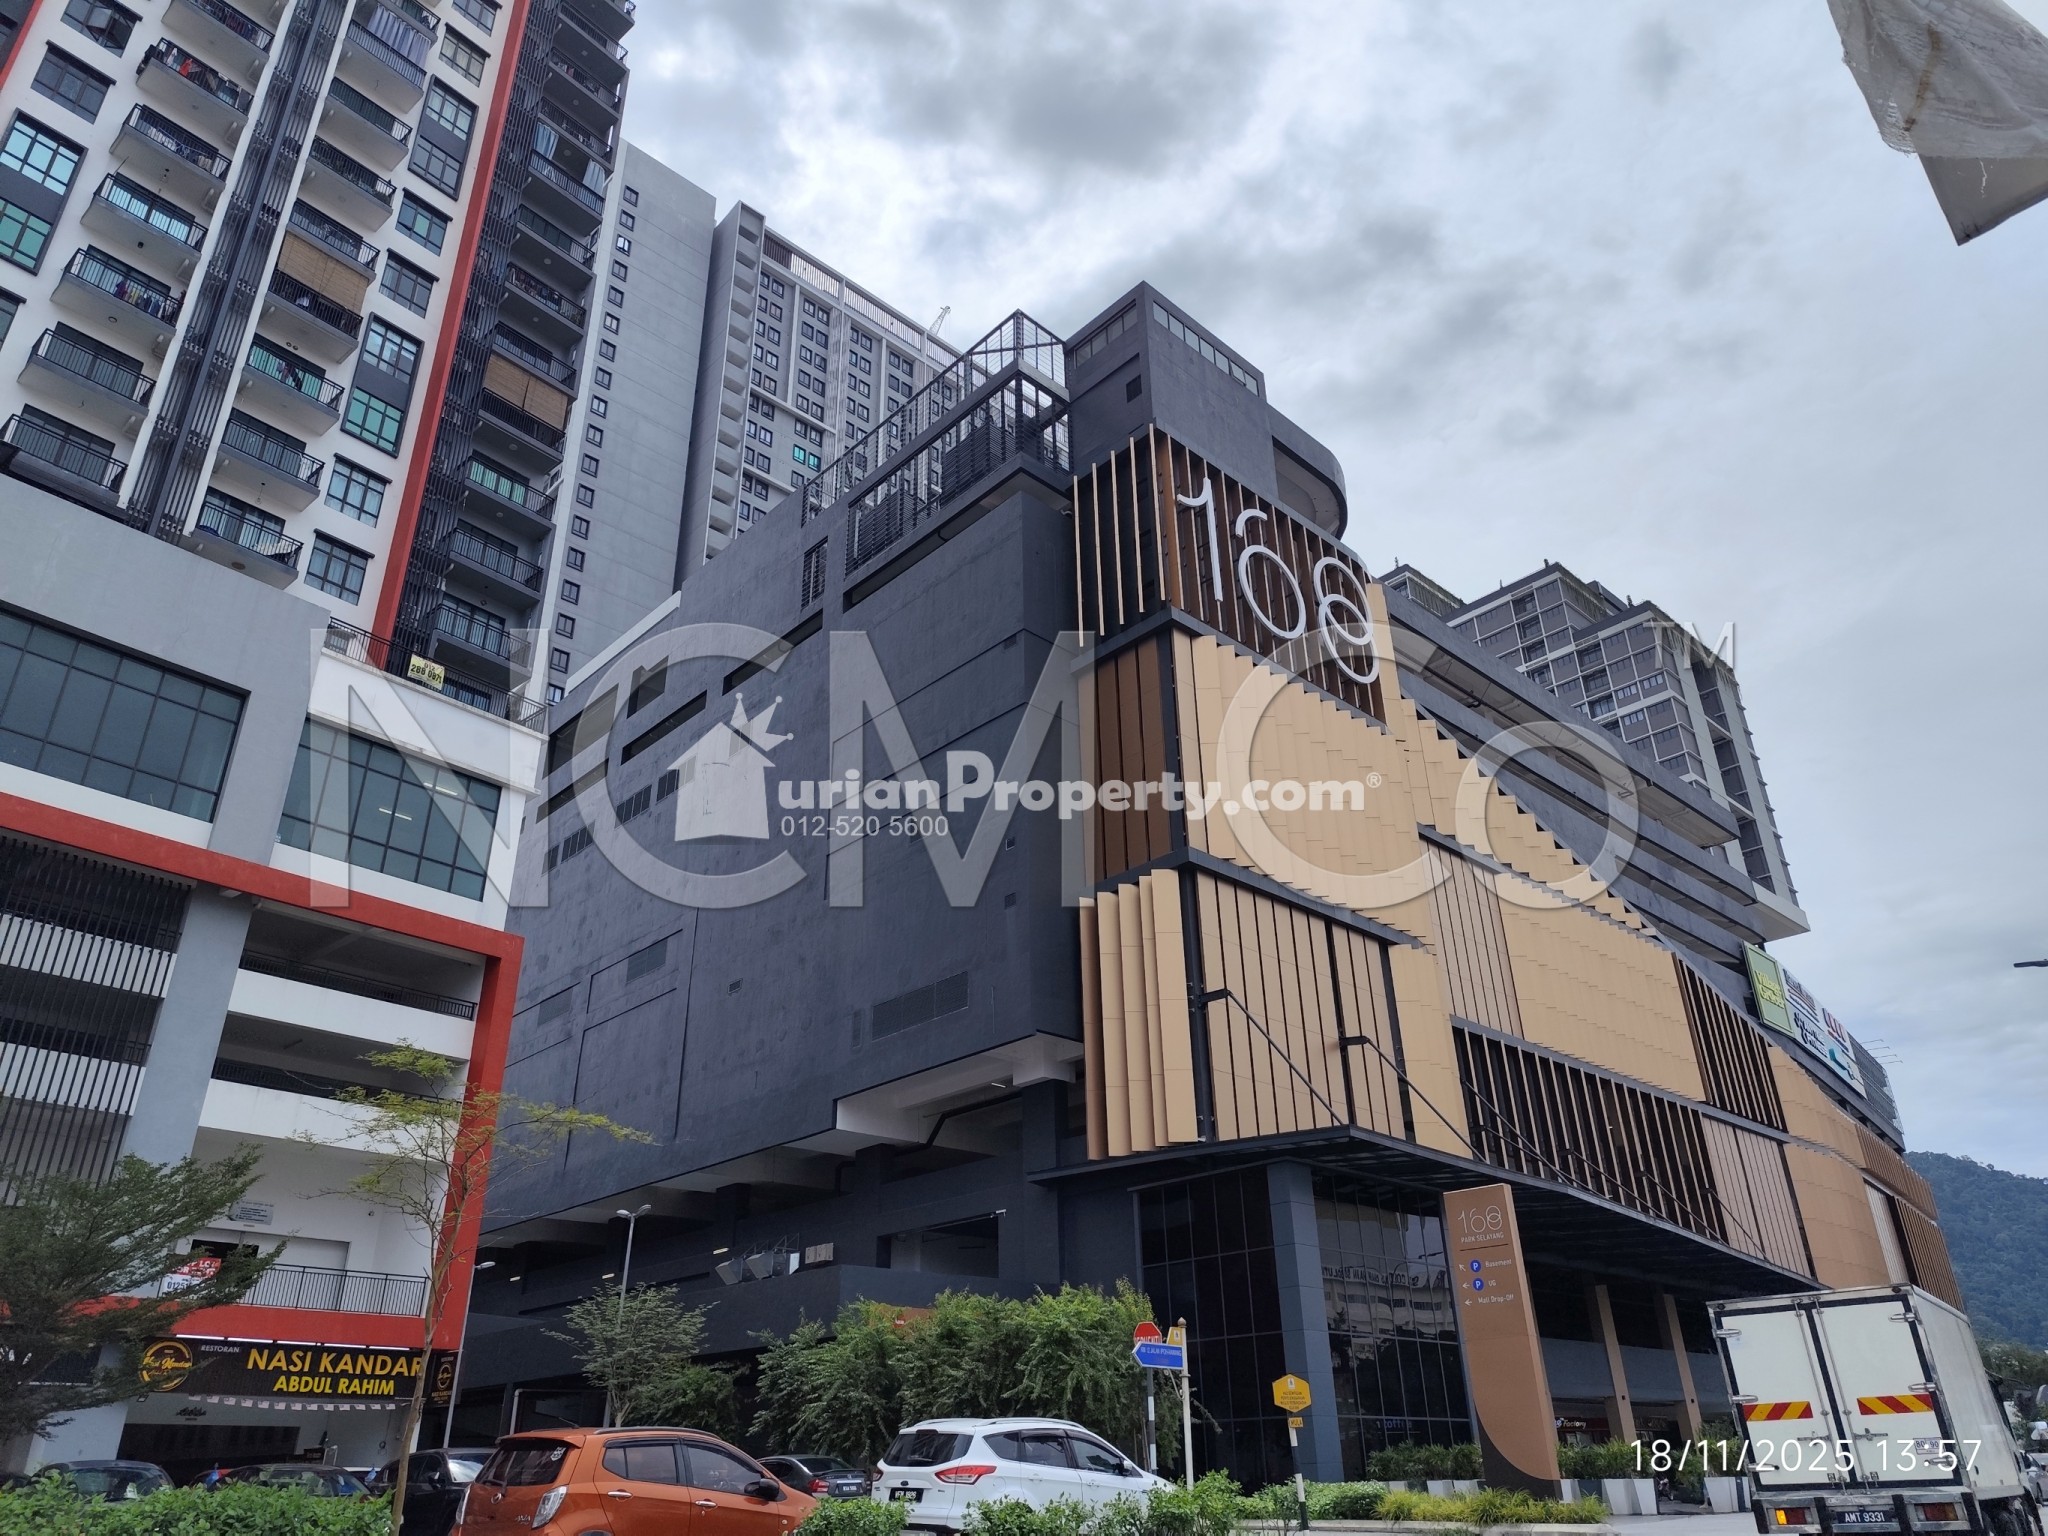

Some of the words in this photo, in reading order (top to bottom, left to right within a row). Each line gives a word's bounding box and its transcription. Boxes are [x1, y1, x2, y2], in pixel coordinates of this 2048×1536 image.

[1177, 477, 1380, 684] 168
[1457, 1205, 1503, 1233] 168
[1460, 1234, 1476, 1244] PARK
[1476, 1232, 1505, 1242] SELAYANG
[1485, 1258, 1512, 1268] Basement
[1477, 1296, 1490, 1304] Mall
[201, 1345, 241, 1353] RESTORAN
[246, 1348, 312, 1373] NASI
[273, 1375, 333, 1393] ABDUL
[337, 1378, 395, 1396] RAHIM
[1845, 1512, 1862, 1523] AMT
[1862, 1511, 1886, 1522] 9331
